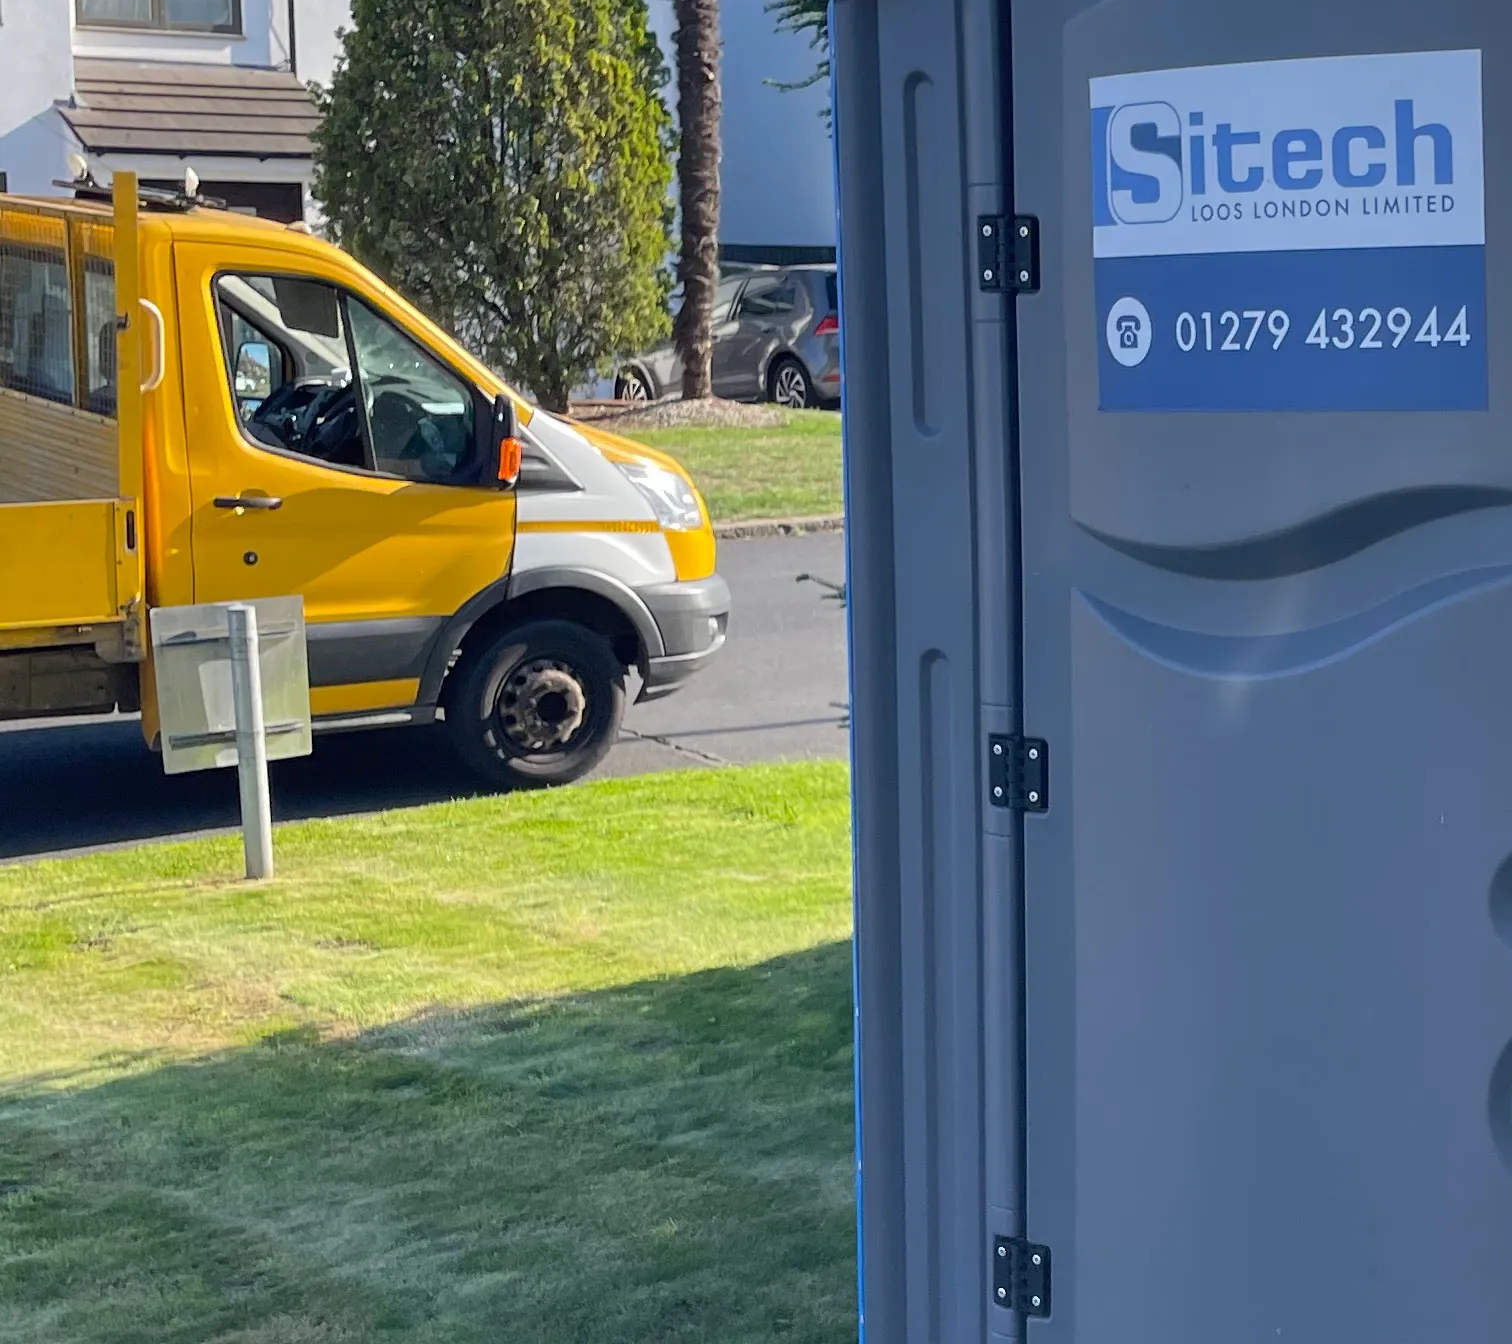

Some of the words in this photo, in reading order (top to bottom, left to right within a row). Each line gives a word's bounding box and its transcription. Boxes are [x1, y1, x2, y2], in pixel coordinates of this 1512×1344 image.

[1107, 100, 1454, 224] Sitech
[1191, 203, 1243, 222] LOOS
[1254, 198, 1350, 218] LONDON
[1362, 195, 1456, 215] LIMITED
[1175, 309, 1290, 352] 01279
[1305, 304, 1471, 349] 432944
